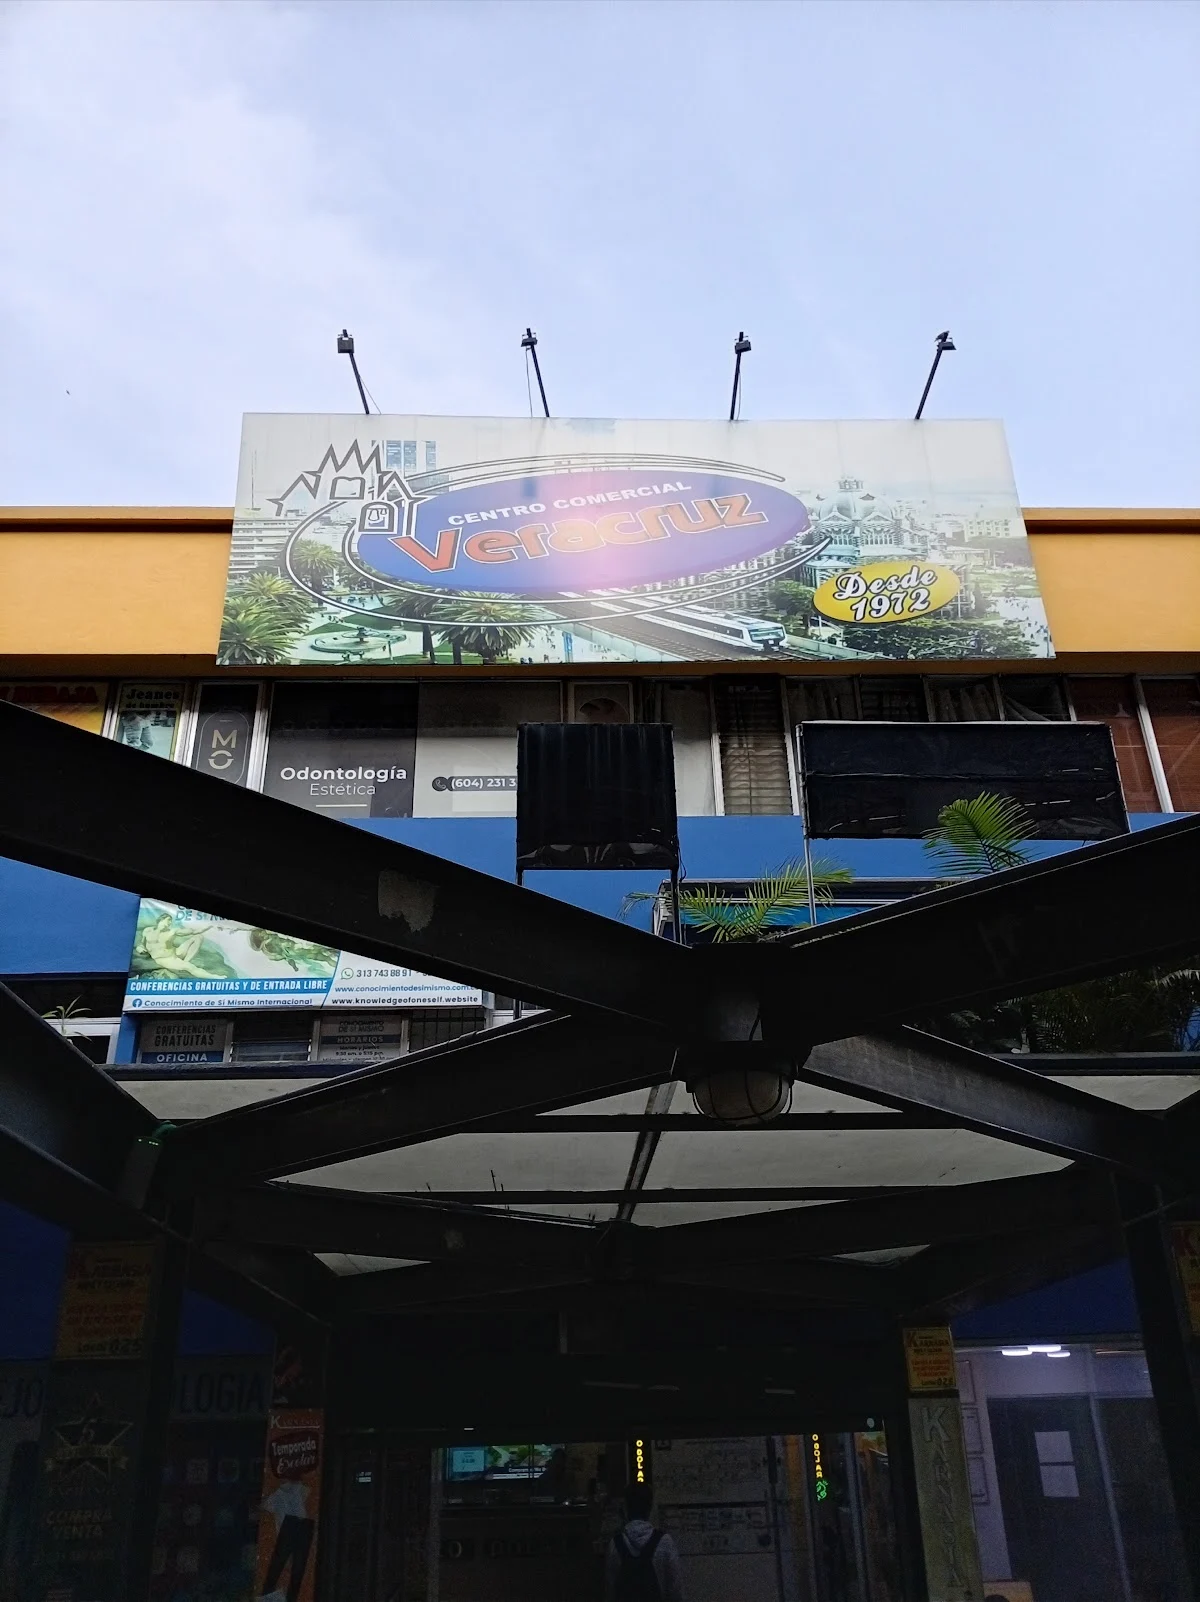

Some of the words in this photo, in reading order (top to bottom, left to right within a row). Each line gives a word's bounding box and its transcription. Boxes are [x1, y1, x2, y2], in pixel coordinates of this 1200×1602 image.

[448, 503, 546, 525] CENTRO
[553, 481, 692, 509] COMERCIAL
[388, 492, 769, 573] Veracruz
[833, 565, 937, 600] Desde
[850, 587, 930, 621] 1972
[126, 688, 180, 700] Jeanes
[280, 765, 407, 783] Odontología
[451, 777, 483, 789] (604)
[487, 778, 506, 788] 231
[309, 783, 376, 796] Estética
[356, 969, 372, 978] 313
[374, 969, 389, 978] 743
[390, 969, 401, 977] 88
[402, 969, 412, 977] 91
[130, 981, 192, 991] CONFERENCIAS
[195, 981, 240, 991] GRATUITAS
[242, 981, 249, 990] Y
[251, 981, 261, 991] DE
[263, 980, 301, 990] ENTRADA
[304, 980, 327, 990] LIBRE
[144, 999, 203, 1007] Conocimiento
[257, 998, 313, 1006] Internacional
[331, 996, 478, 1005] www.knowledgeofoneself.website
[156, 1024, 216, 1035] CONFERENCIAS
[154, 1034, 215, 1047] GRATUITAS
[337, 1035, 384, 1044] HORARIOS
[156, 1053, 208, 1063] OFICINA
[272, 1436, 316, 1456] Temporada
